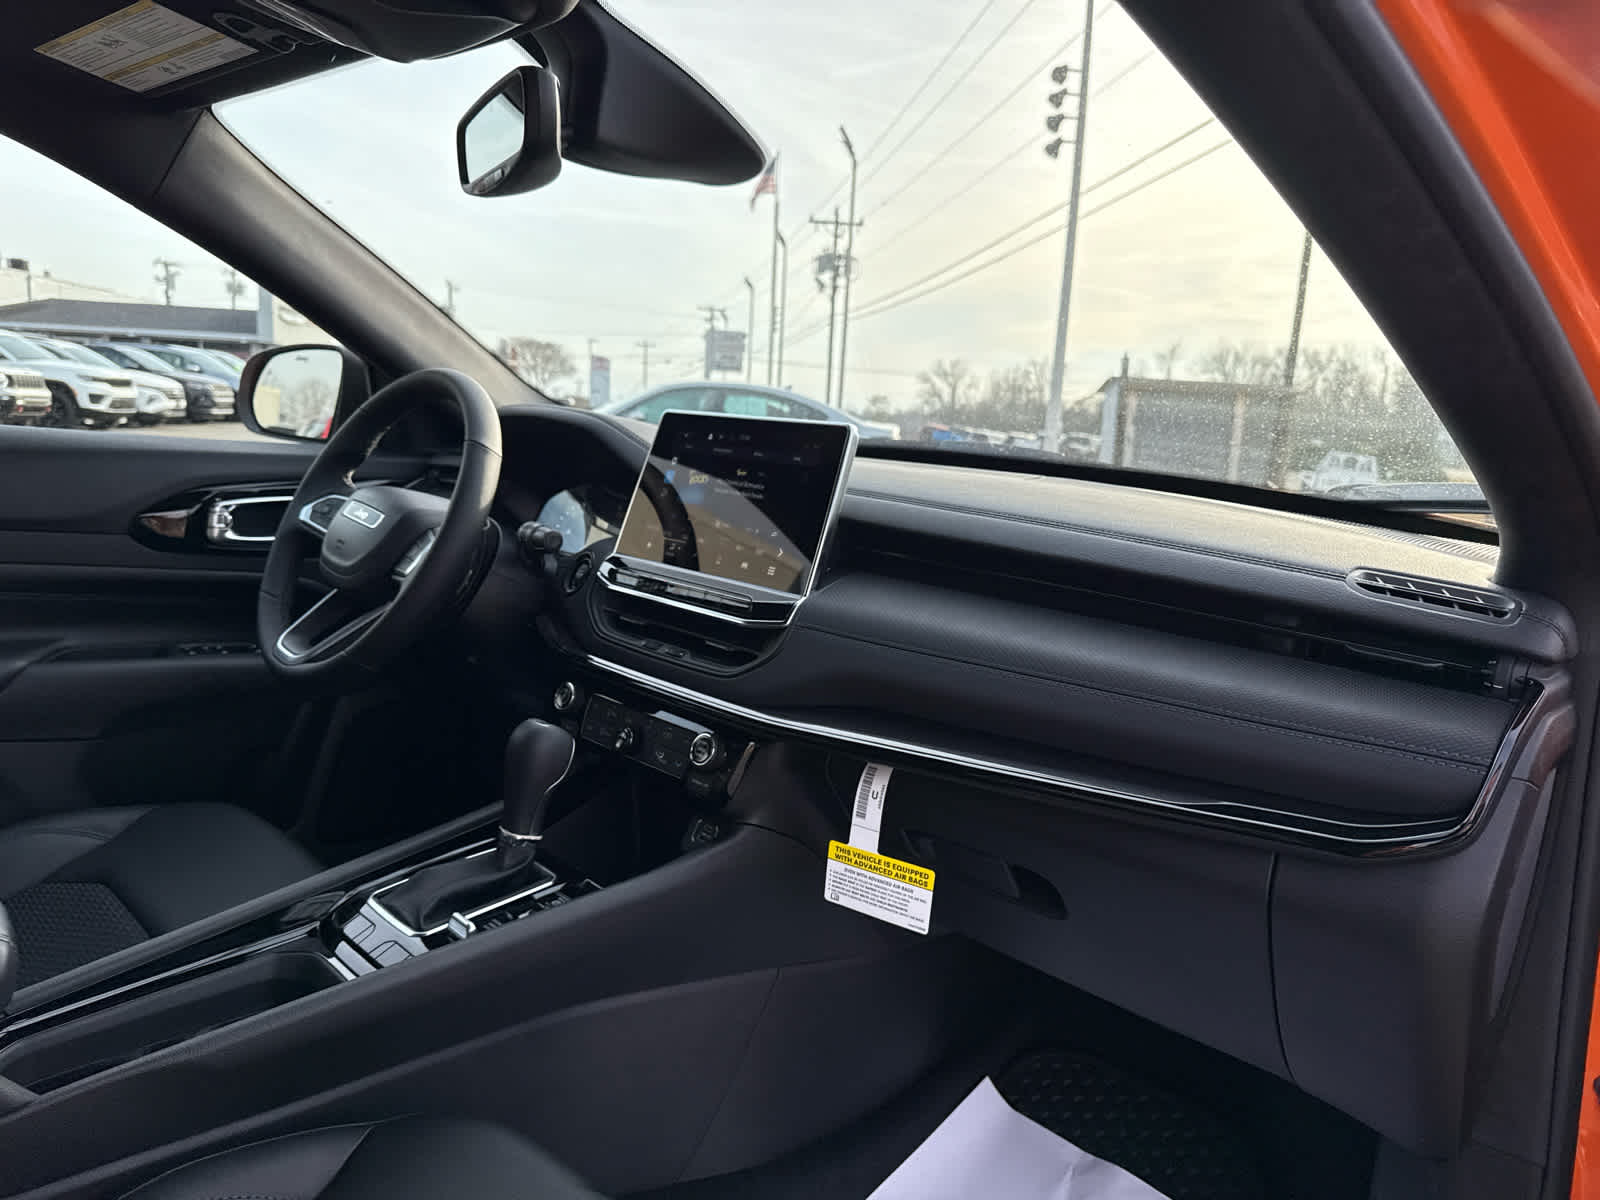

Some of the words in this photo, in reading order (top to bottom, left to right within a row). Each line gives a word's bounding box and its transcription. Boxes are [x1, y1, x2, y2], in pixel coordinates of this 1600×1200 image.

[834, 854, 853, 864] WITH
[854, 859, 893, 876] ADVANCED
[895, 871, 907, 880] AIR
[908, 876, 928, 887] BAGS
[835, 846, 851, 856] THIS
[853, 850, 882, 865] VEHICLE
[893, 863, 929, 879] EQUIPPED
[868, 875, 892, 886] ADVANCED
